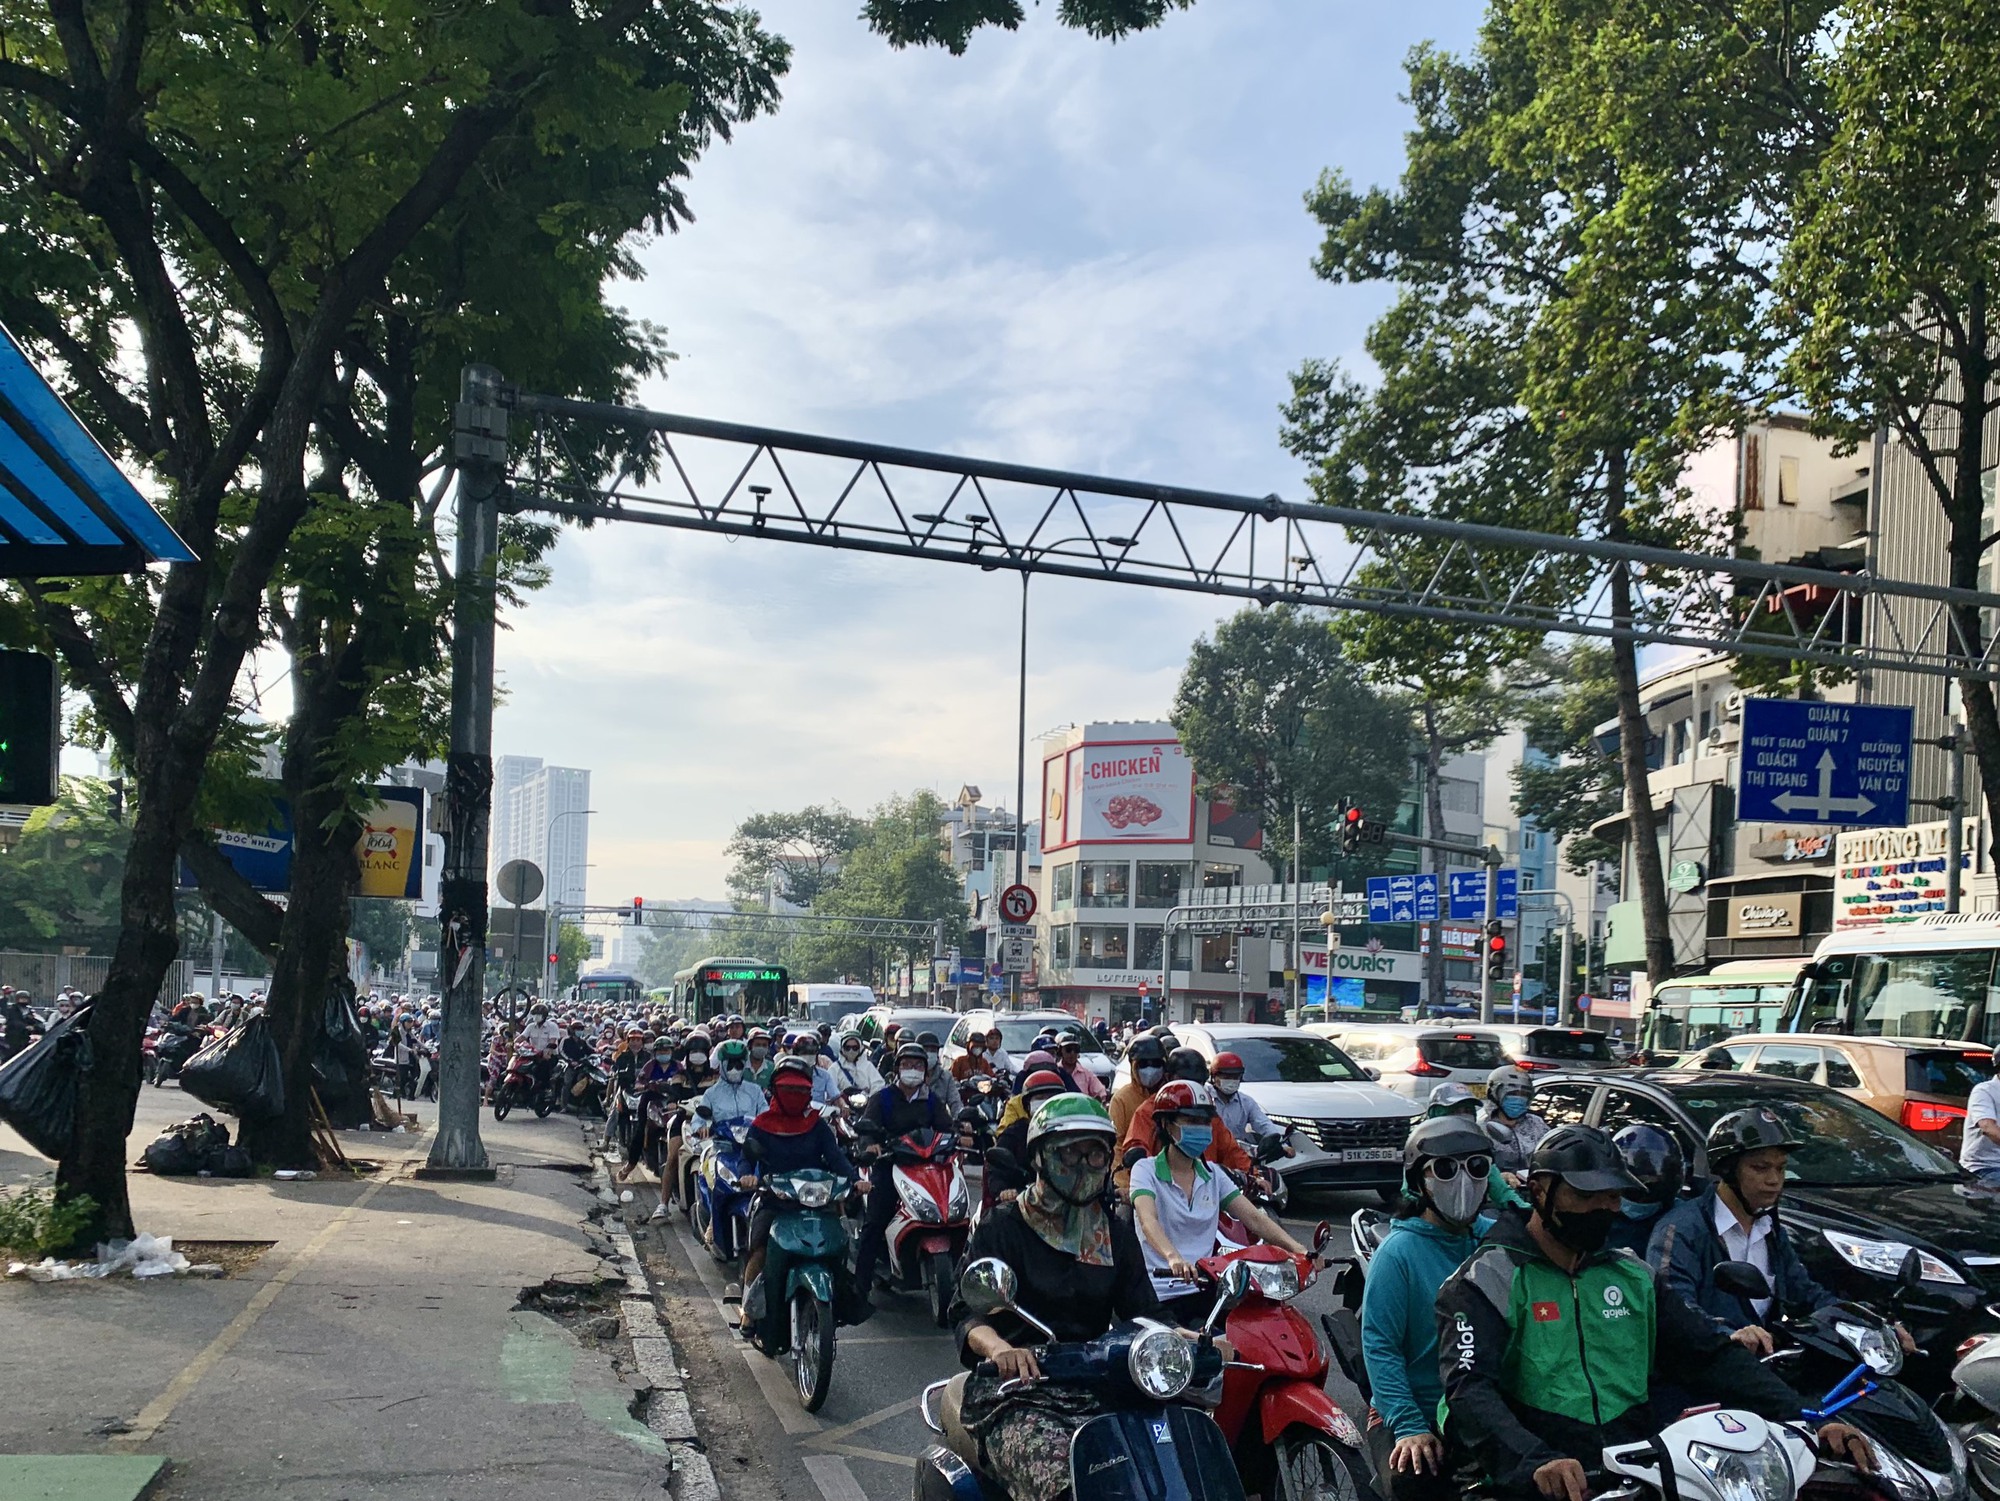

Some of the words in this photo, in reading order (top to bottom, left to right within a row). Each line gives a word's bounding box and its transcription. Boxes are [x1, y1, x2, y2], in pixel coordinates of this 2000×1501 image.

[1808, 705, 1840, 724] QUẬN
[1843, 711, 1850, 723] 4
[1751, 734, 1775, 747] NÚT
[1779, 737, 1806, 749] GIAO
[1807, 725, 1839, 744] QUẬN
[1842, 729, 1849, 743] 7
[1757, 750, 1797, 767] QUÁCH
[1858, 752, 1905, 773] NGUYỄN
[1746, 770, 1766, 788] THỊ
[1769, 771, 1808, 788] TRANG
[1859, 775, 1882, 790] VĂN
[367, 836, 393, 849] 1664
[1925, 825, 1973, 854] MI
[360, 860, 400, 870] BLANC
[1096, 973, 1153, 984] LOTTERIA
[1602, 1306, 1631, 1319] gojek
